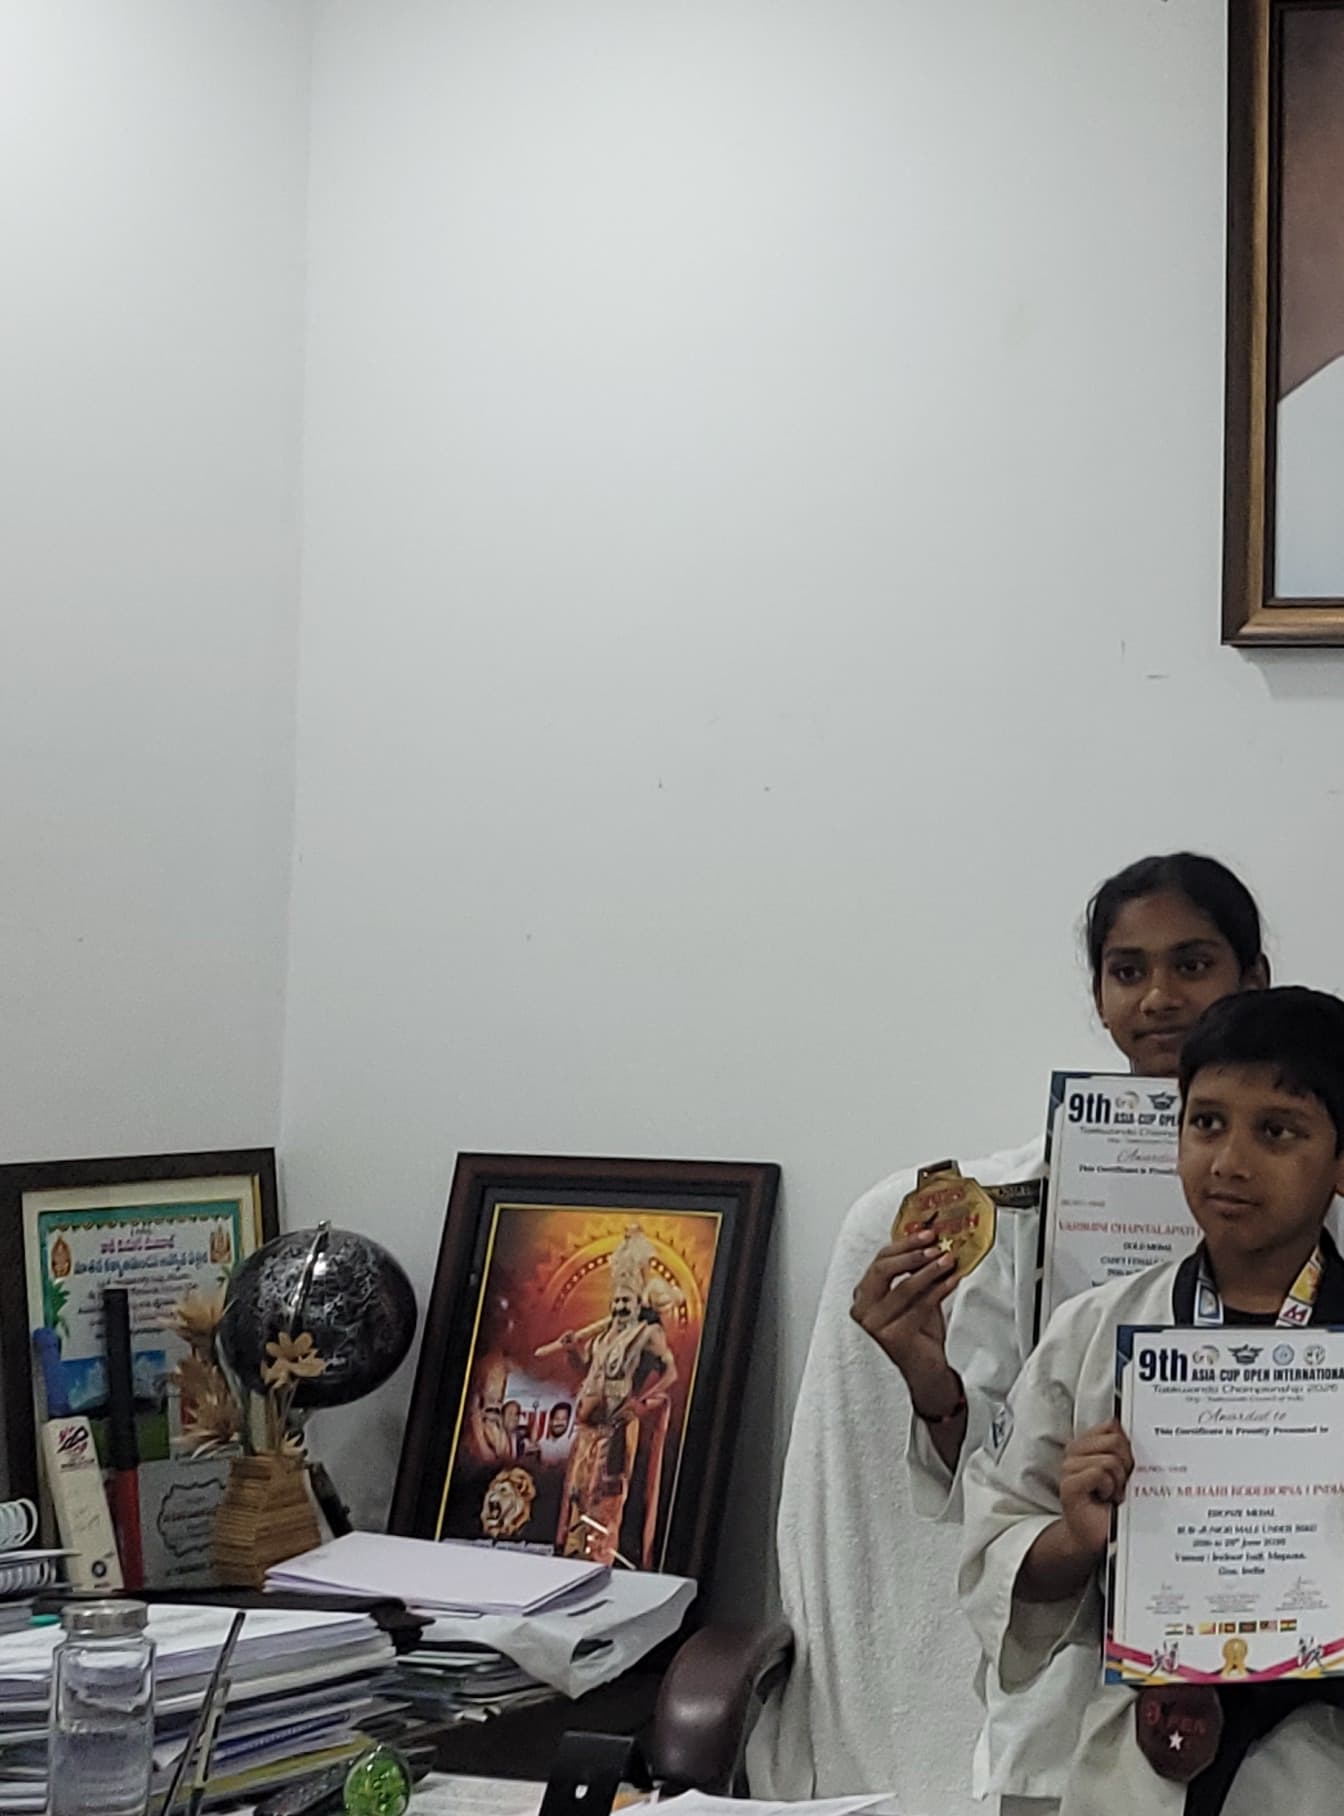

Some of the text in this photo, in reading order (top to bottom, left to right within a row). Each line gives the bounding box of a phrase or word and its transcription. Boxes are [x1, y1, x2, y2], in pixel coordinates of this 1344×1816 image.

[1068, 1093, 1155, 1125] 9th ASIA CUP
[1139, 1349, 1188, 1382] 9th
[1192, 1369, 1215, 1382] ASIA
[1220, 1368, 1240, 1382] CUP
[1244, 1368, 1270, 1382] OPEN
